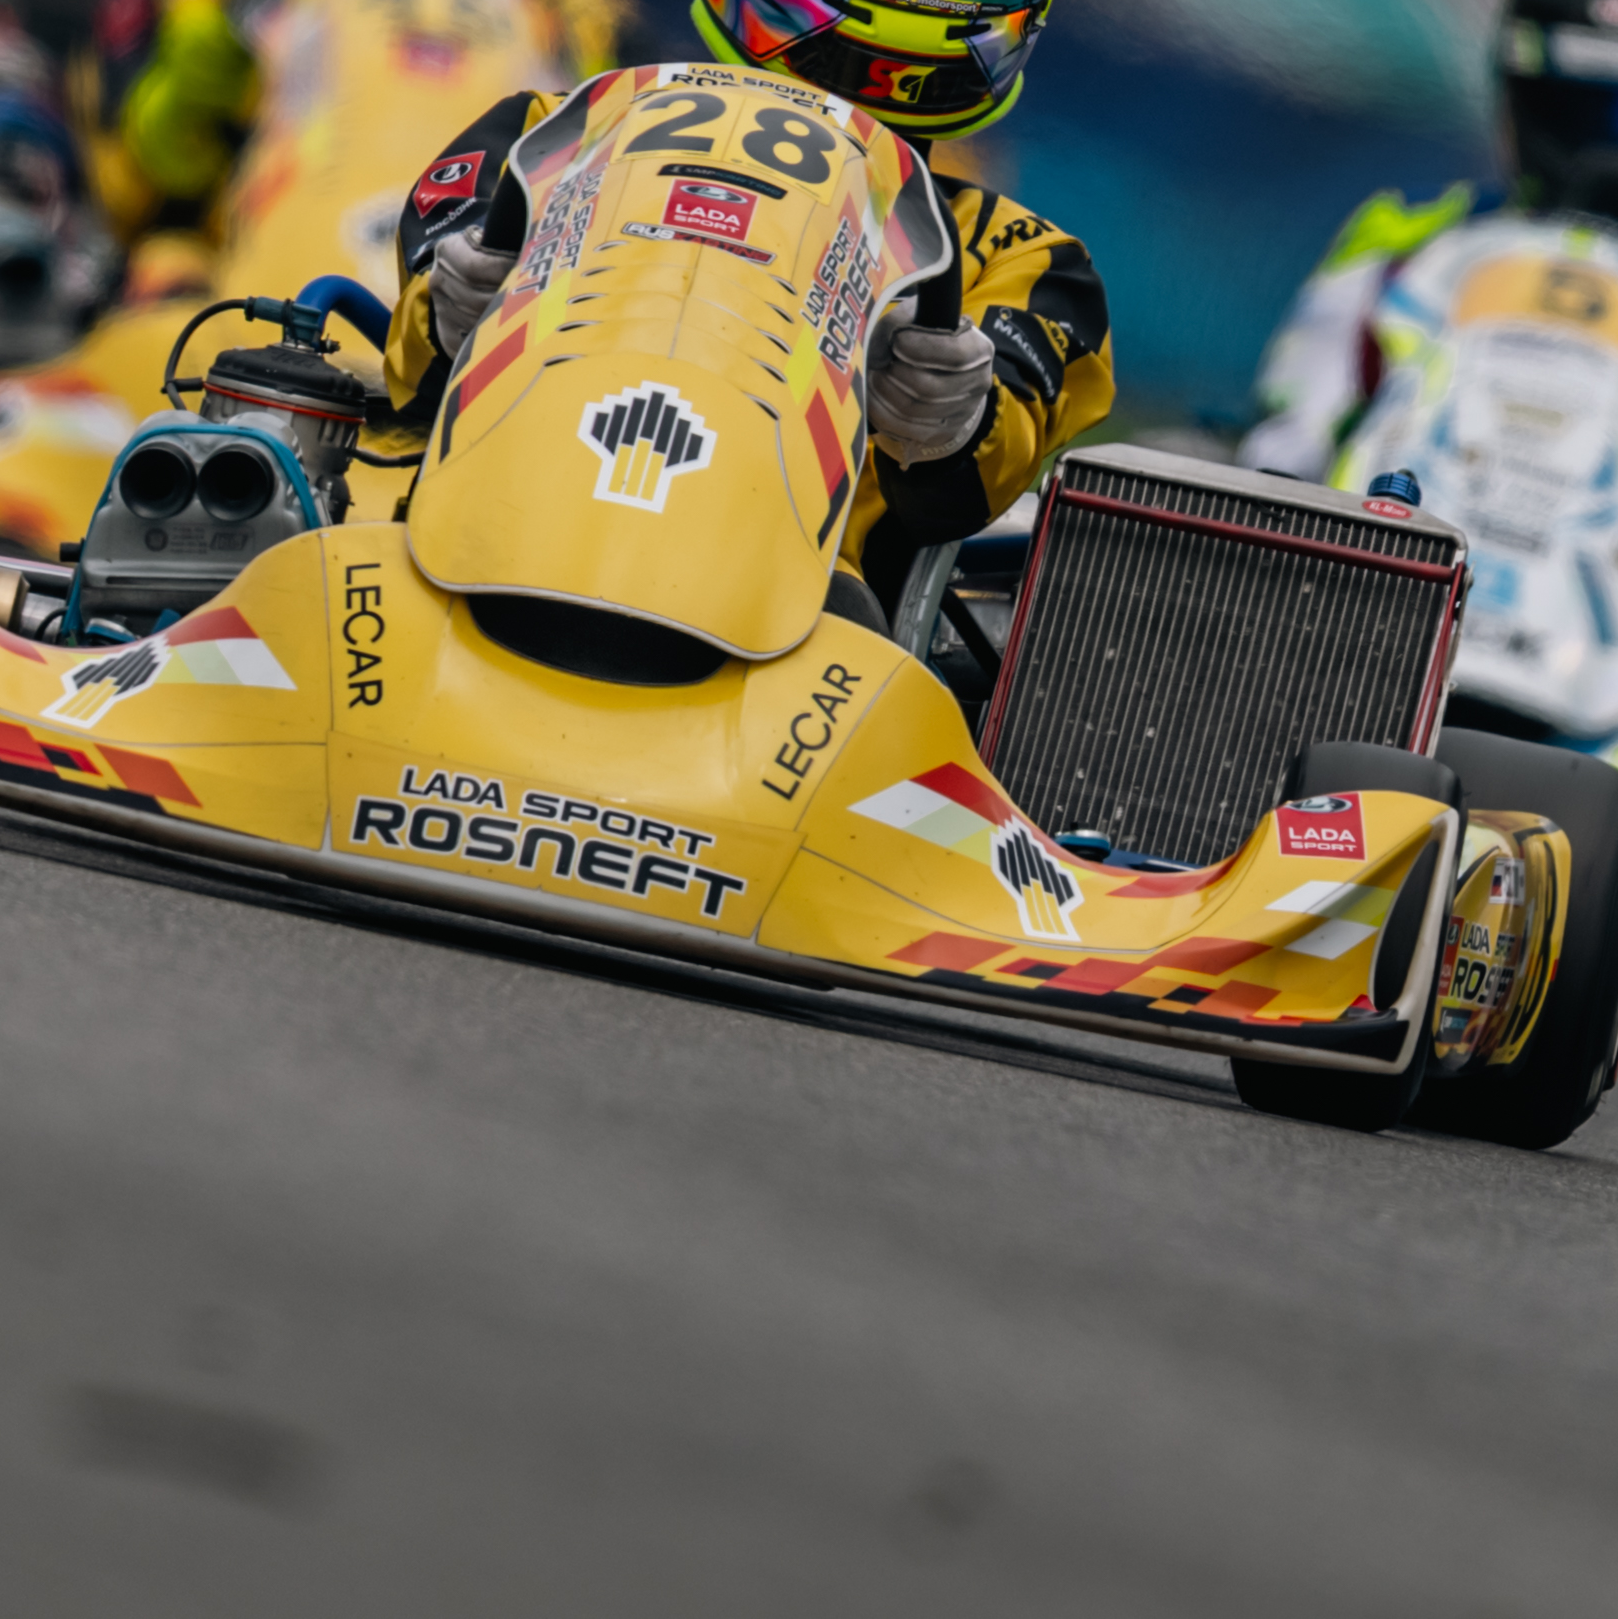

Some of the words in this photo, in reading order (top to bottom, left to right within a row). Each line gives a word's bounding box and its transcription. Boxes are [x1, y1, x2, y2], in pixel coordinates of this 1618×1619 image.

[691, 67, 735, 81] LADA
[742, 76, 822, 100] SPORT
[623, 92, 837, 185] 28
[559, 204, 592, 269] SPORT
[673, 214, 741, 233] SPORT
[675, 203, 741, 227] LADA
[801, 283, 830, 328] LADA
[819, 218, 856, 288] SPORT
[818, 232, 880, 371] ROSNEFT
[342, 563, 386, 709] LECAR
[761, 662, 863, 801] LECAR
[401, 767, 505, 809] LADA
[522, 792, 714, 856] SPORT
[1288, 826, 1356, 843] LADA
[1290, 841, 1358, 853] SPORT
[350, 798, 746, 917] ROSNEFT
[1461, 922, 1491, 955] LADA
